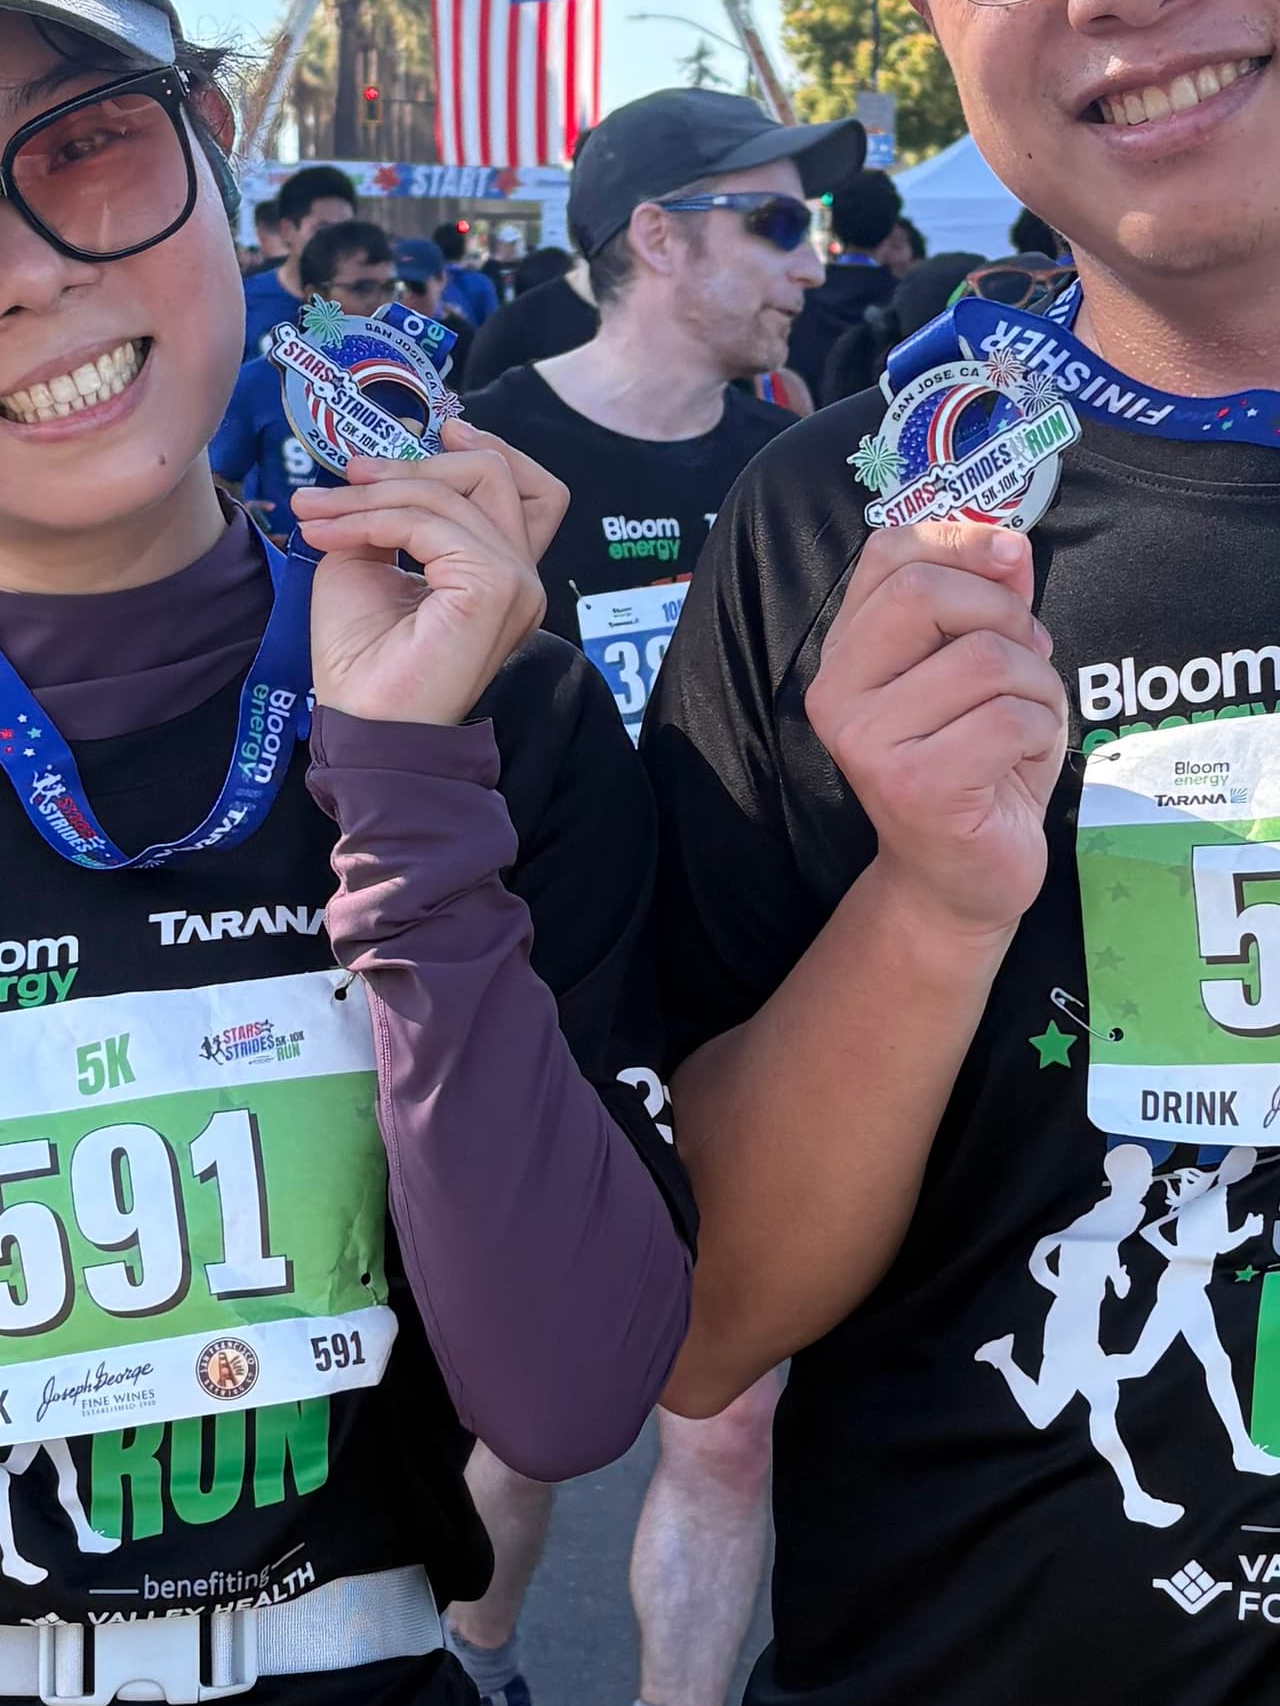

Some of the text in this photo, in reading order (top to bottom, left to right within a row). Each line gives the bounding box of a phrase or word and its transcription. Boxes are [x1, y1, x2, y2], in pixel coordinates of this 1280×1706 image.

[410, 167, 492, 197] START
[284, 340, 333, 383] STARS
[980, 320, 1175, 426] FINISHER
[918, 369, 955, 394] JOSE
[959, 367, 980, 378] CA
[331, 386, 395, 440] STRIDES
[341, 421, 379, 453] 5K-10K
[1026, 411, 1070, 457] RUN
[948, 443, 1012, 501] STRIDES
[981, 469, 1020, 506] 5K-10K
[885, 480, 936, 527] STARS
[602, 516, 680, 541] Bloom
[609, 538, 680, 560] energy
[662, 597, 683, 623] 10
[241, 683, 270, 779] energy
[255, 689, 297, 784] Bloom
[1174, 761, 1230, 775] Bloom
[1174, 772, 1229, 787] energy
[1154, 793, 1227, 807] TARANA
[39, 801, 91, 855] STRIDES
[223, 1021, 263, 1044] STARS
[225, 1035, 275, 1061] STRIDES
[76, 1032, 136, 1096] 5K
[276, 1043, 301, 1062] RUN
[1141, 1089, 1239, 1126] DRINK
[310, 1330, 366, 1372] 591
[81, 1389, 155, 1409] FINE WINES
[90, 1395, 330, 1541] RUN
[143, 1568, 270, 1600] benefiting
